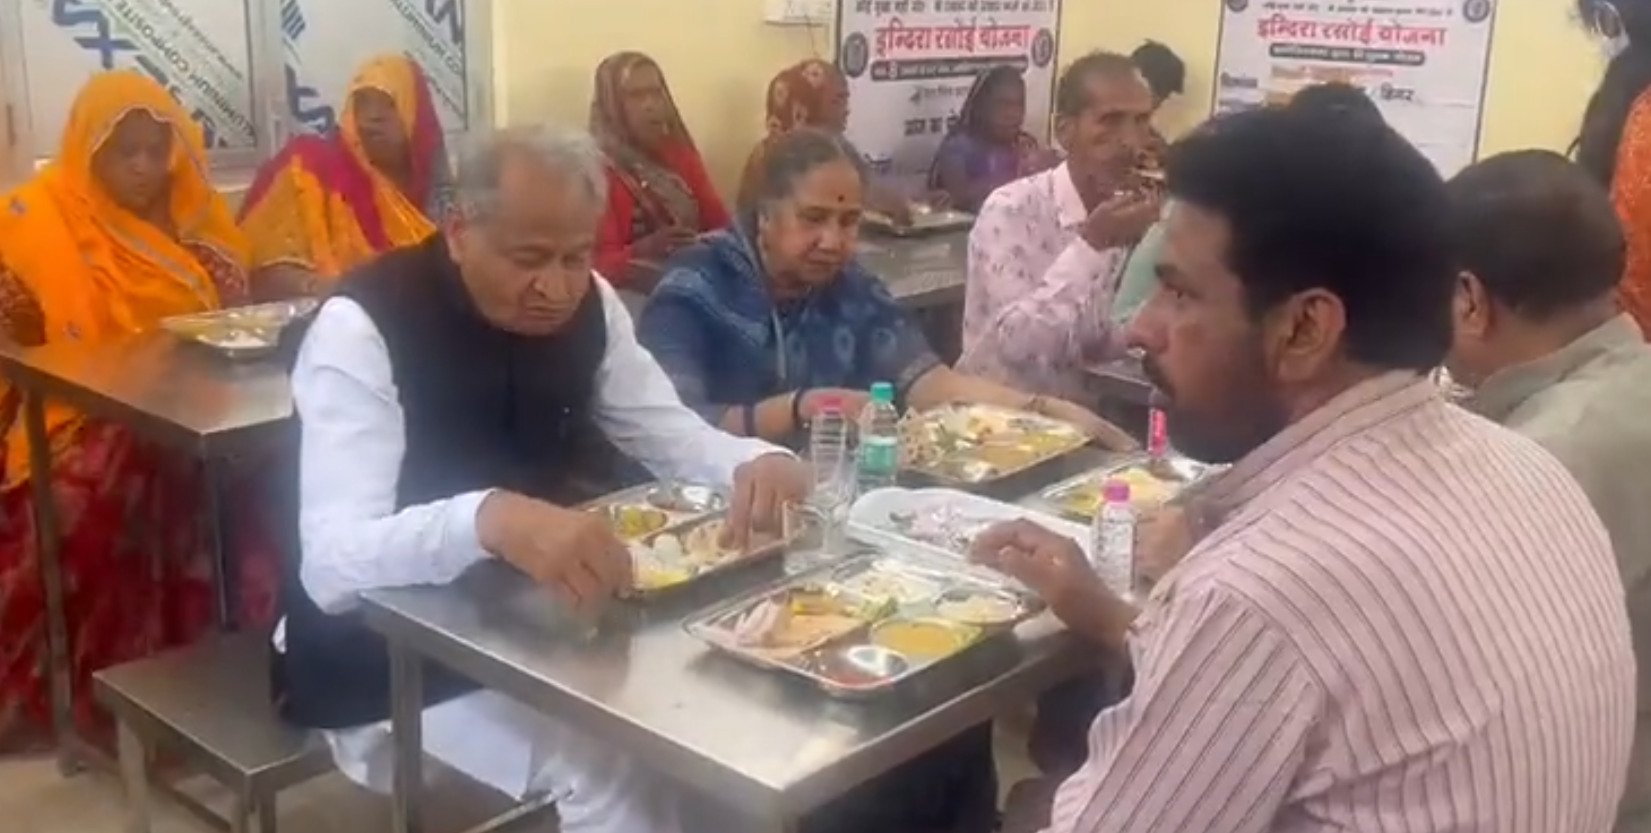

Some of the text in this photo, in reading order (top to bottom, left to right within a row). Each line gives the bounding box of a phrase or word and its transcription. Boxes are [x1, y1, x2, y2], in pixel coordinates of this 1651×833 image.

[115, 0, 189, 73] COMPOSITE
[935, 18, 976, 51] रसोई
[1322, 16, 1373, 45] रसोई
[1378, 18, 1448, 46] योजना
